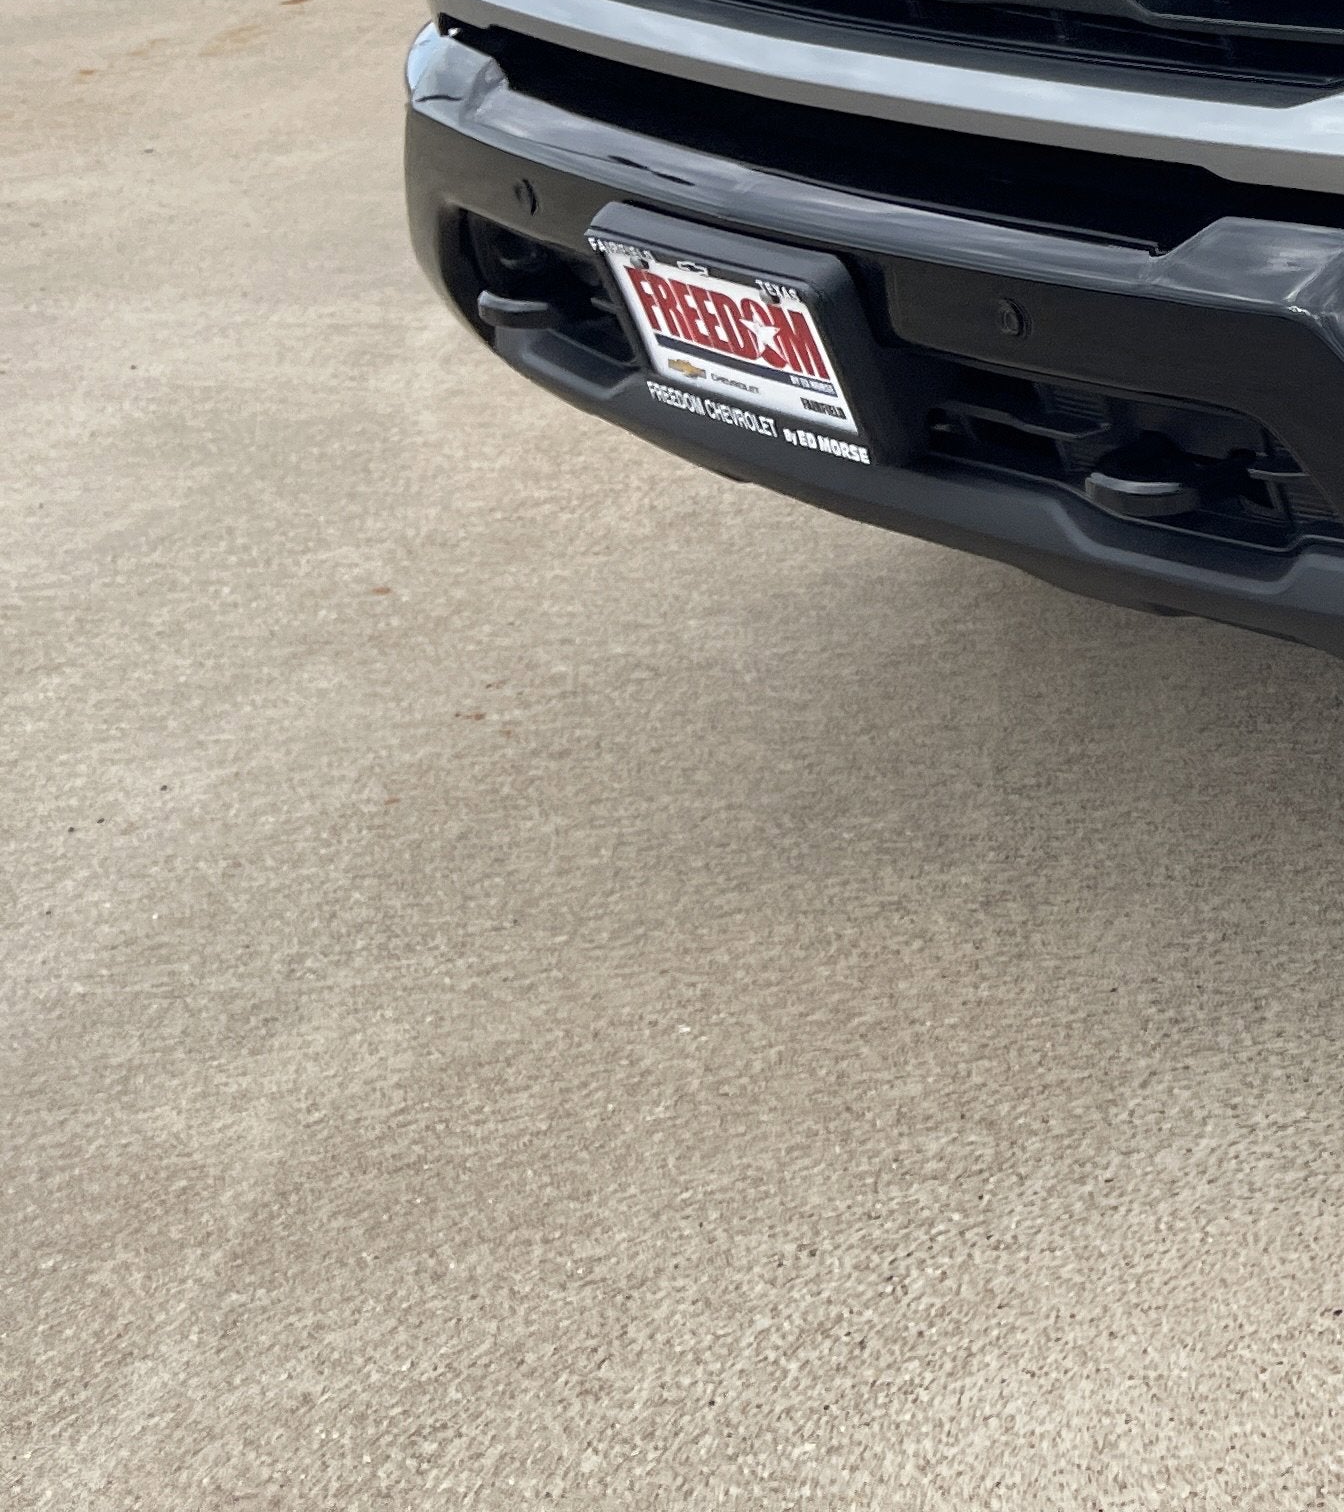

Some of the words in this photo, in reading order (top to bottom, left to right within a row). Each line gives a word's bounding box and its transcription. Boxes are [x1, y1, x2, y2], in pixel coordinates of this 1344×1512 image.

[623, 265, 831, 381] FREEDOM
[755, 279, 800, 302] TEXAS
[647, 380, 706, 416] FREEDOM
[704, 399, 778, 438] CHEVROLET
[797, 430, 818, 449] ED
[817, 435, 871, 465] MORSE
